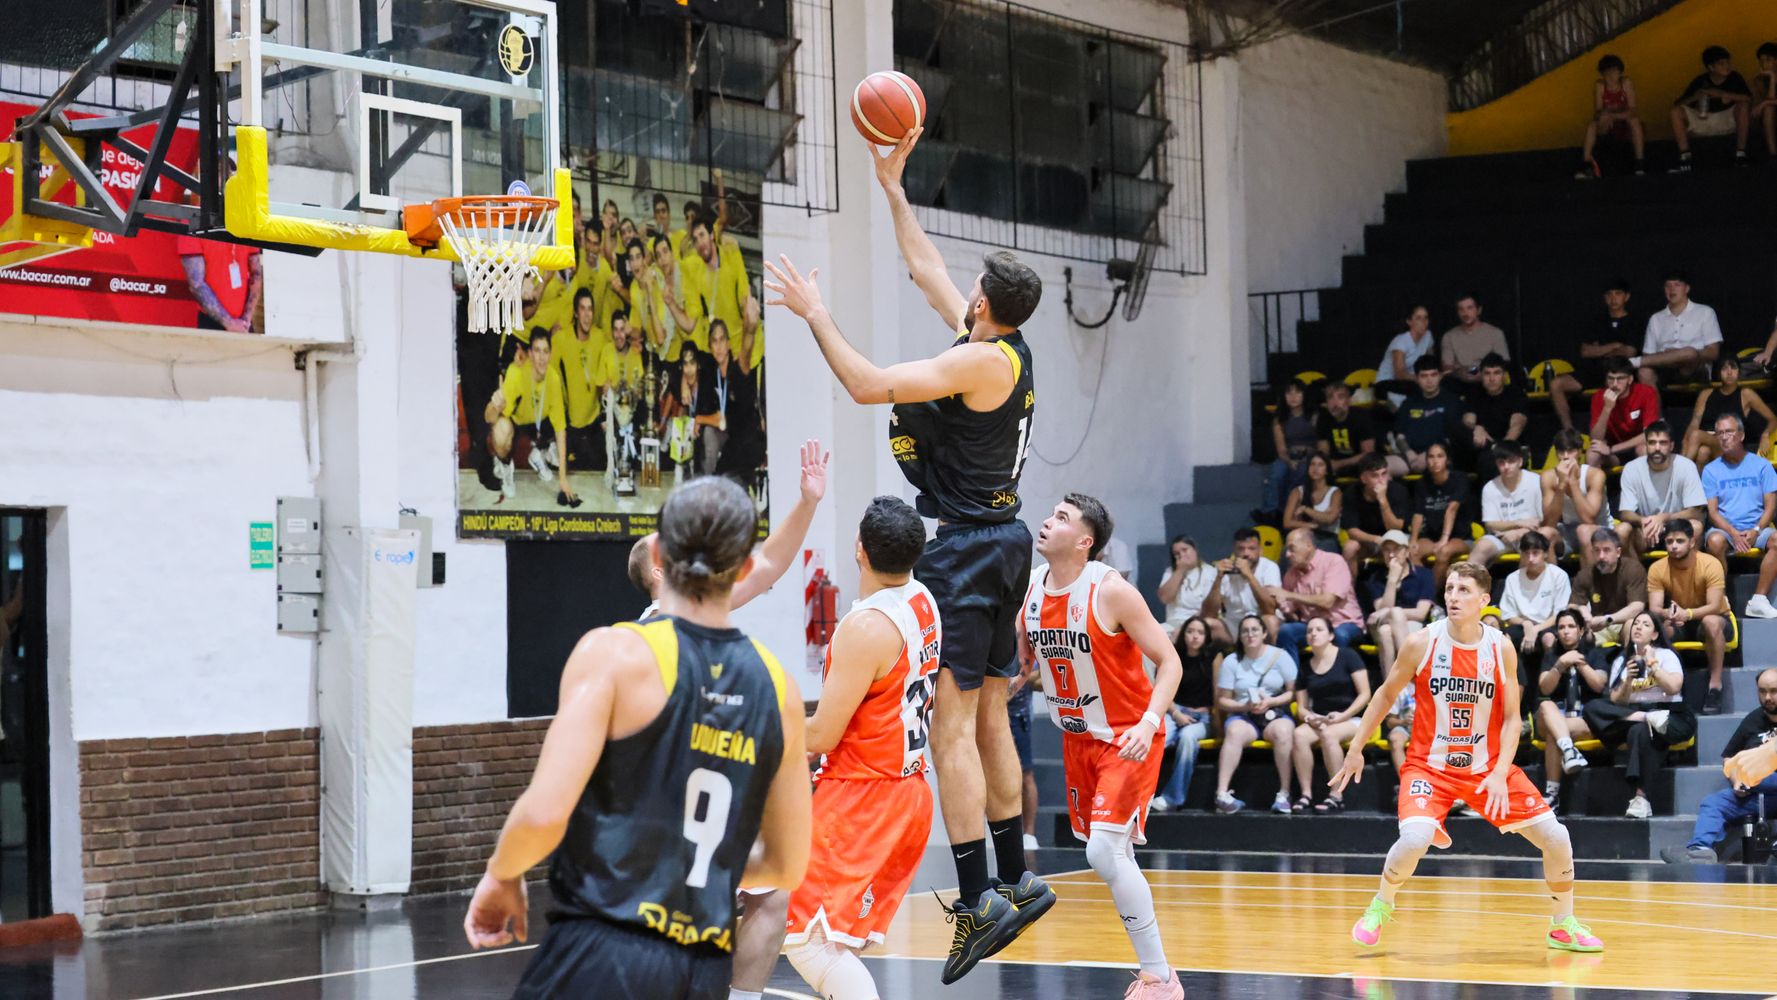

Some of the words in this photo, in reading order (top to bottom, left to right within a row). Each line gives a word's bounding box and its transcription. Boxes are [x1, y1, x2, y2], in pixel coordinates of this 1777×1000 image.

[92, 231, 115, 245] ADA
[110, 277, 167, 294] @bacar_sa
[1332, 428, 1351, 449] H
[463, 512, 487, 531] HINDÚ
[488, 513, 526, 532] CAMPEÓN
[543, 516, 559, 535] Liga
[1027, 629, 1091, 654] SPORTIVO
[1041, 646, 1074, 660] SUARDI
[1057, 665, 1067, 690] 7
[1430, 677, 1495, 700] SPORTIVO
[1446, 692, 1479, 704] SUARDI
[1452, 708, 1471, 729] 55
[1437, 733, 1470, 744] PRODAS
[1410, 780, 1433, 796] 55
[1070, 788, 1080, 811] 7
[683, 767, 733, 889] 9
